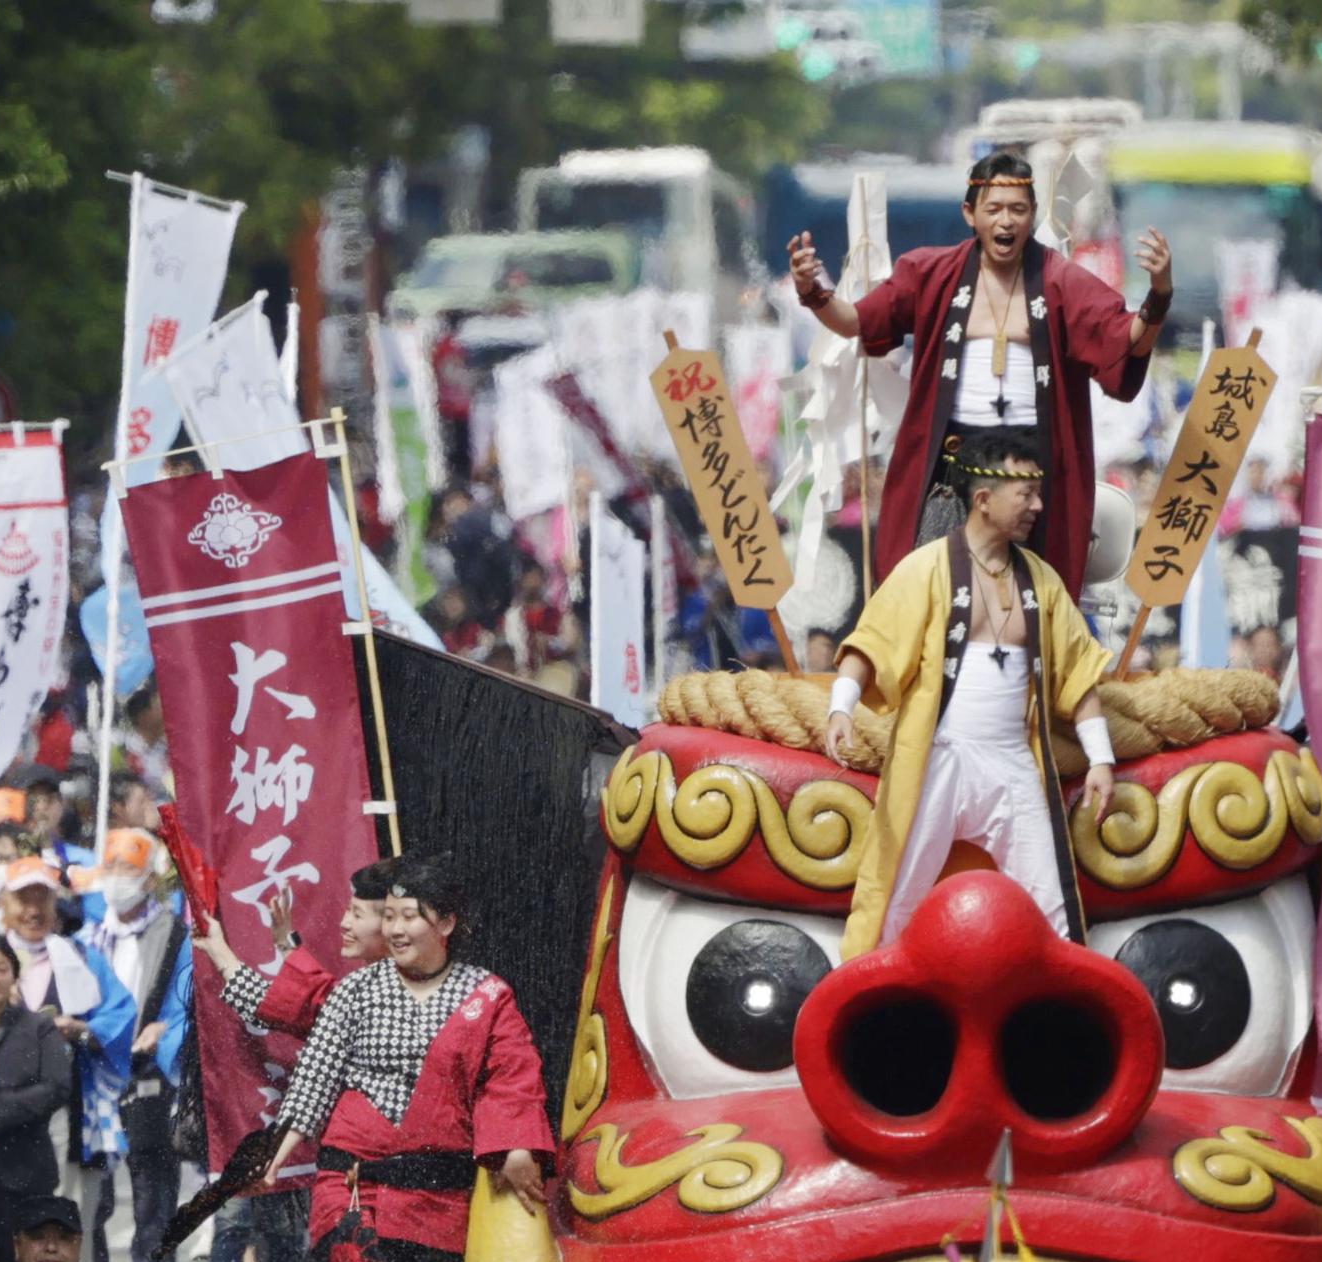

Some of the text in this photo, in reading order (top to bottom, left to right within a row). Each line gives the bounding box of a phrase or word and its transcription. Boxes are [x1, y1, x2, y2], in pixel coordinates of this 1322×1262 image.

[664, 361, 775, 587] 祝 博多どんたく
[1144, 365, 1267, 581] 城島大獅子
